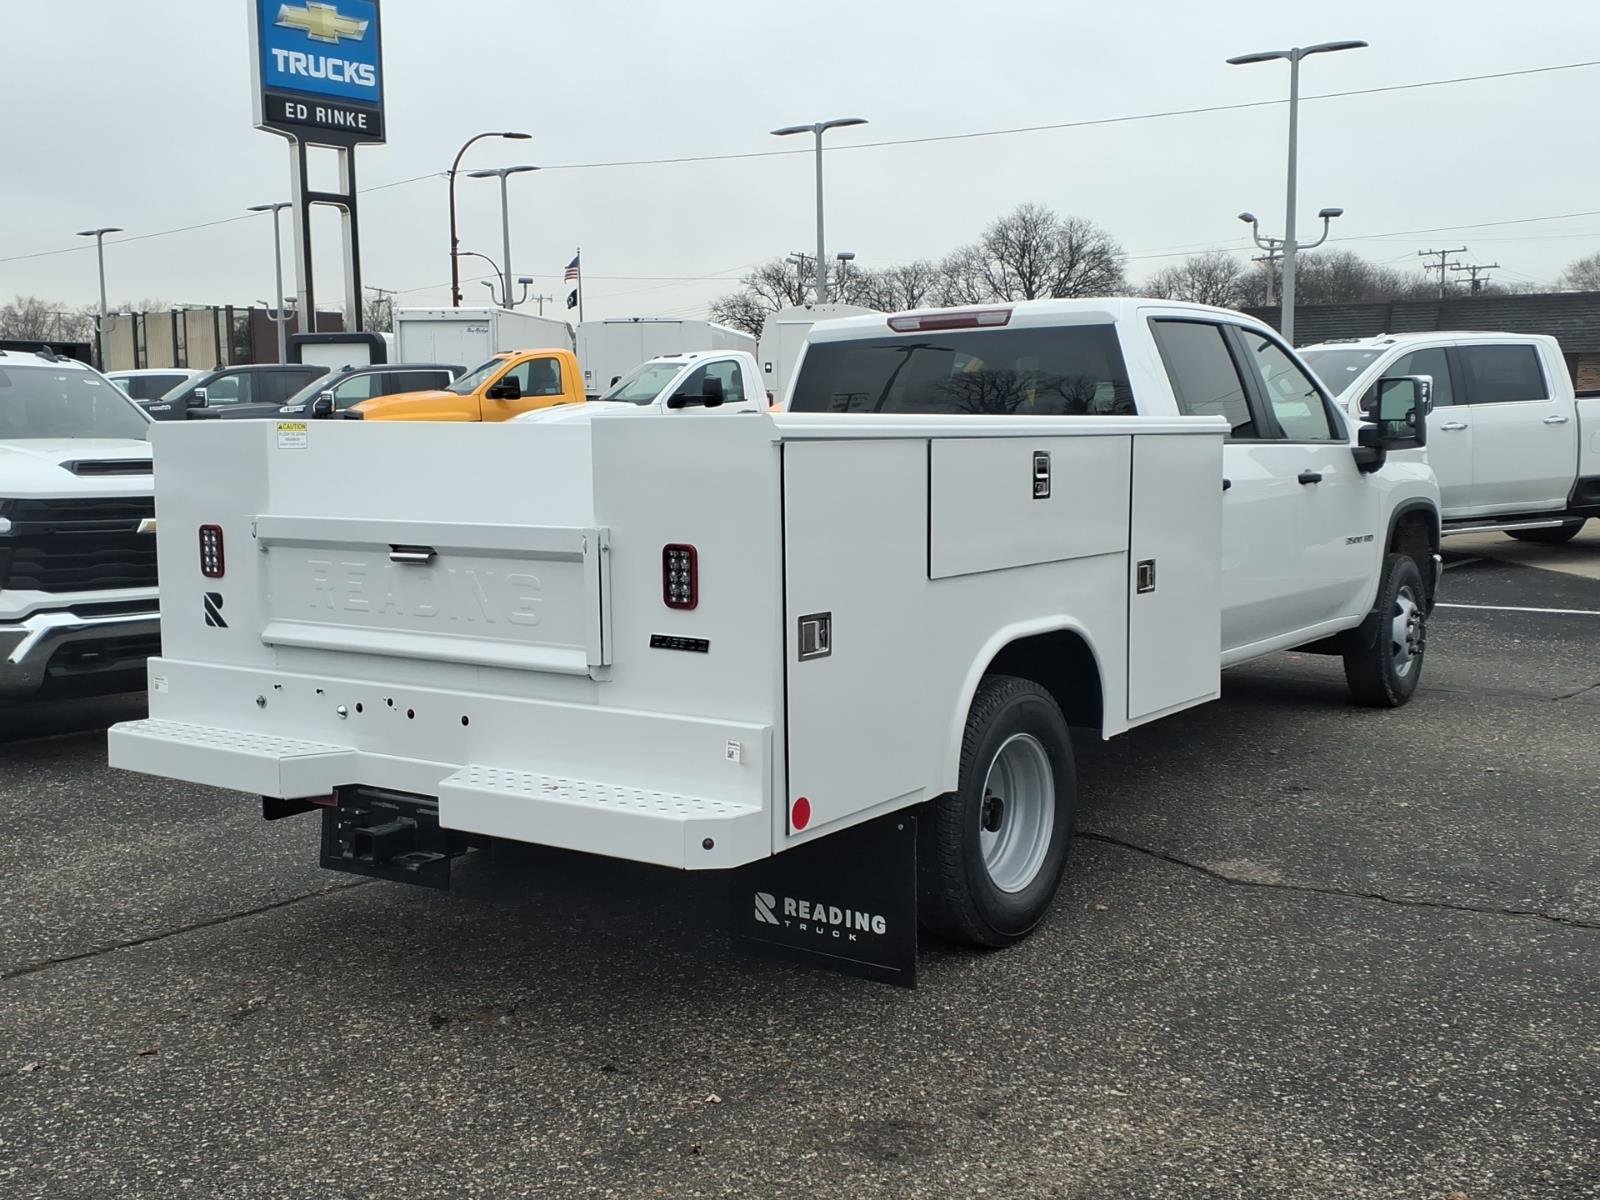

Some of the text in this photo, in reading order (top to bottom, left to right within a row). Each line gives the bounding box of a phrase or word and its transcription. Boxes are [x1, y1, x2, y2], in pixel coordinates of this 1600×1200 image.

[271, 47, 376, 87] TRUCKS
[285, 102, 368, 128] ED RINKE
[307, 560, 543, 627] READING
[783, 896, 887, 935] READING
[784, 920, 857, 942] TRUCK
